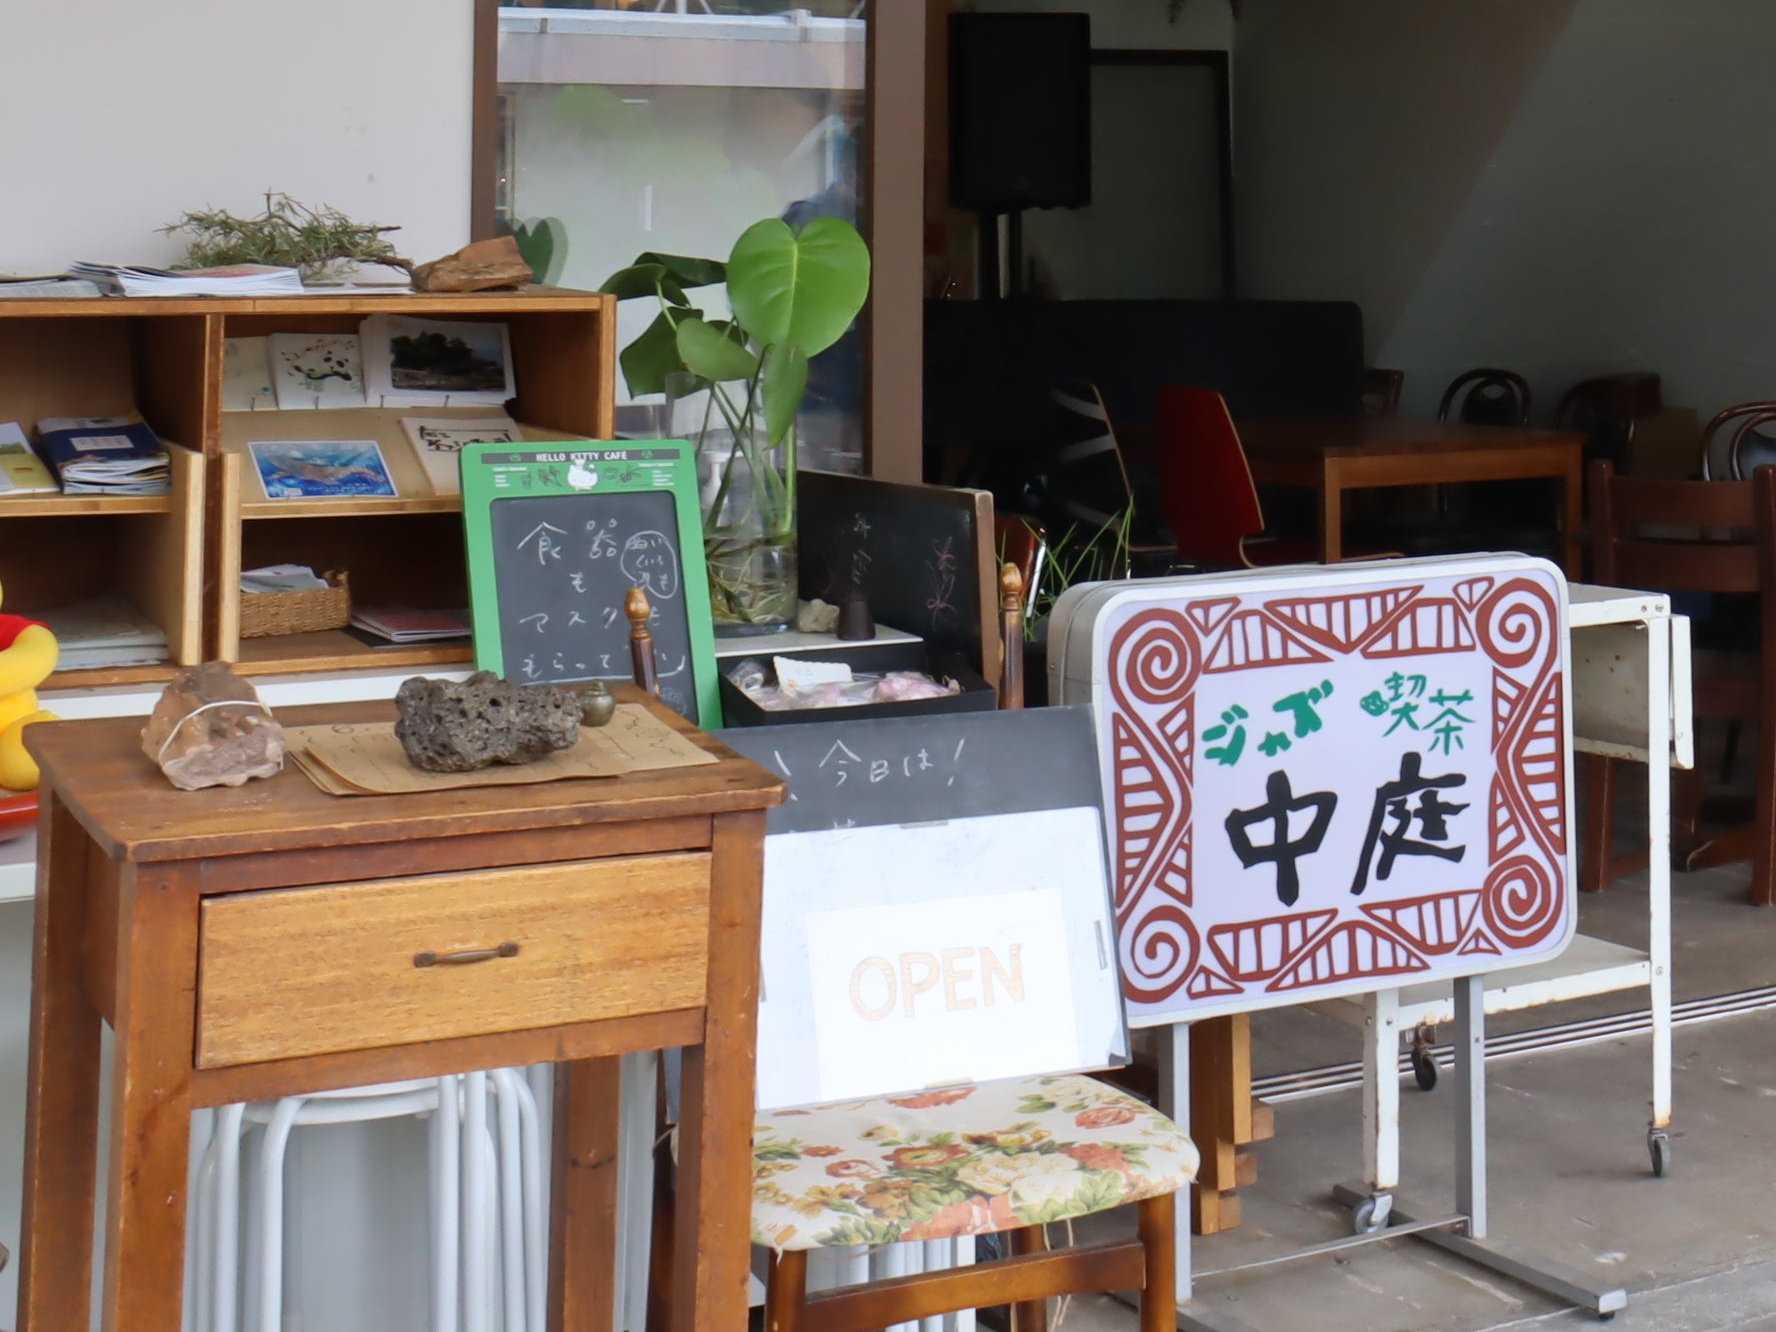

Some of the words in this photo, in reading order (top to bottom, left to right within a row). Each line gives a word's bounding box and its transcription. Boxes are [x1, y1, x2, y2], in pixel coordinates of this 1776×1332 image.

[535, 453, 566, 462] HELLO
[570, 451, 600, 462] KITTY
[1224, 751, 1471, 908] 中庭
[849, 942, 1026, 1022] OPEN
